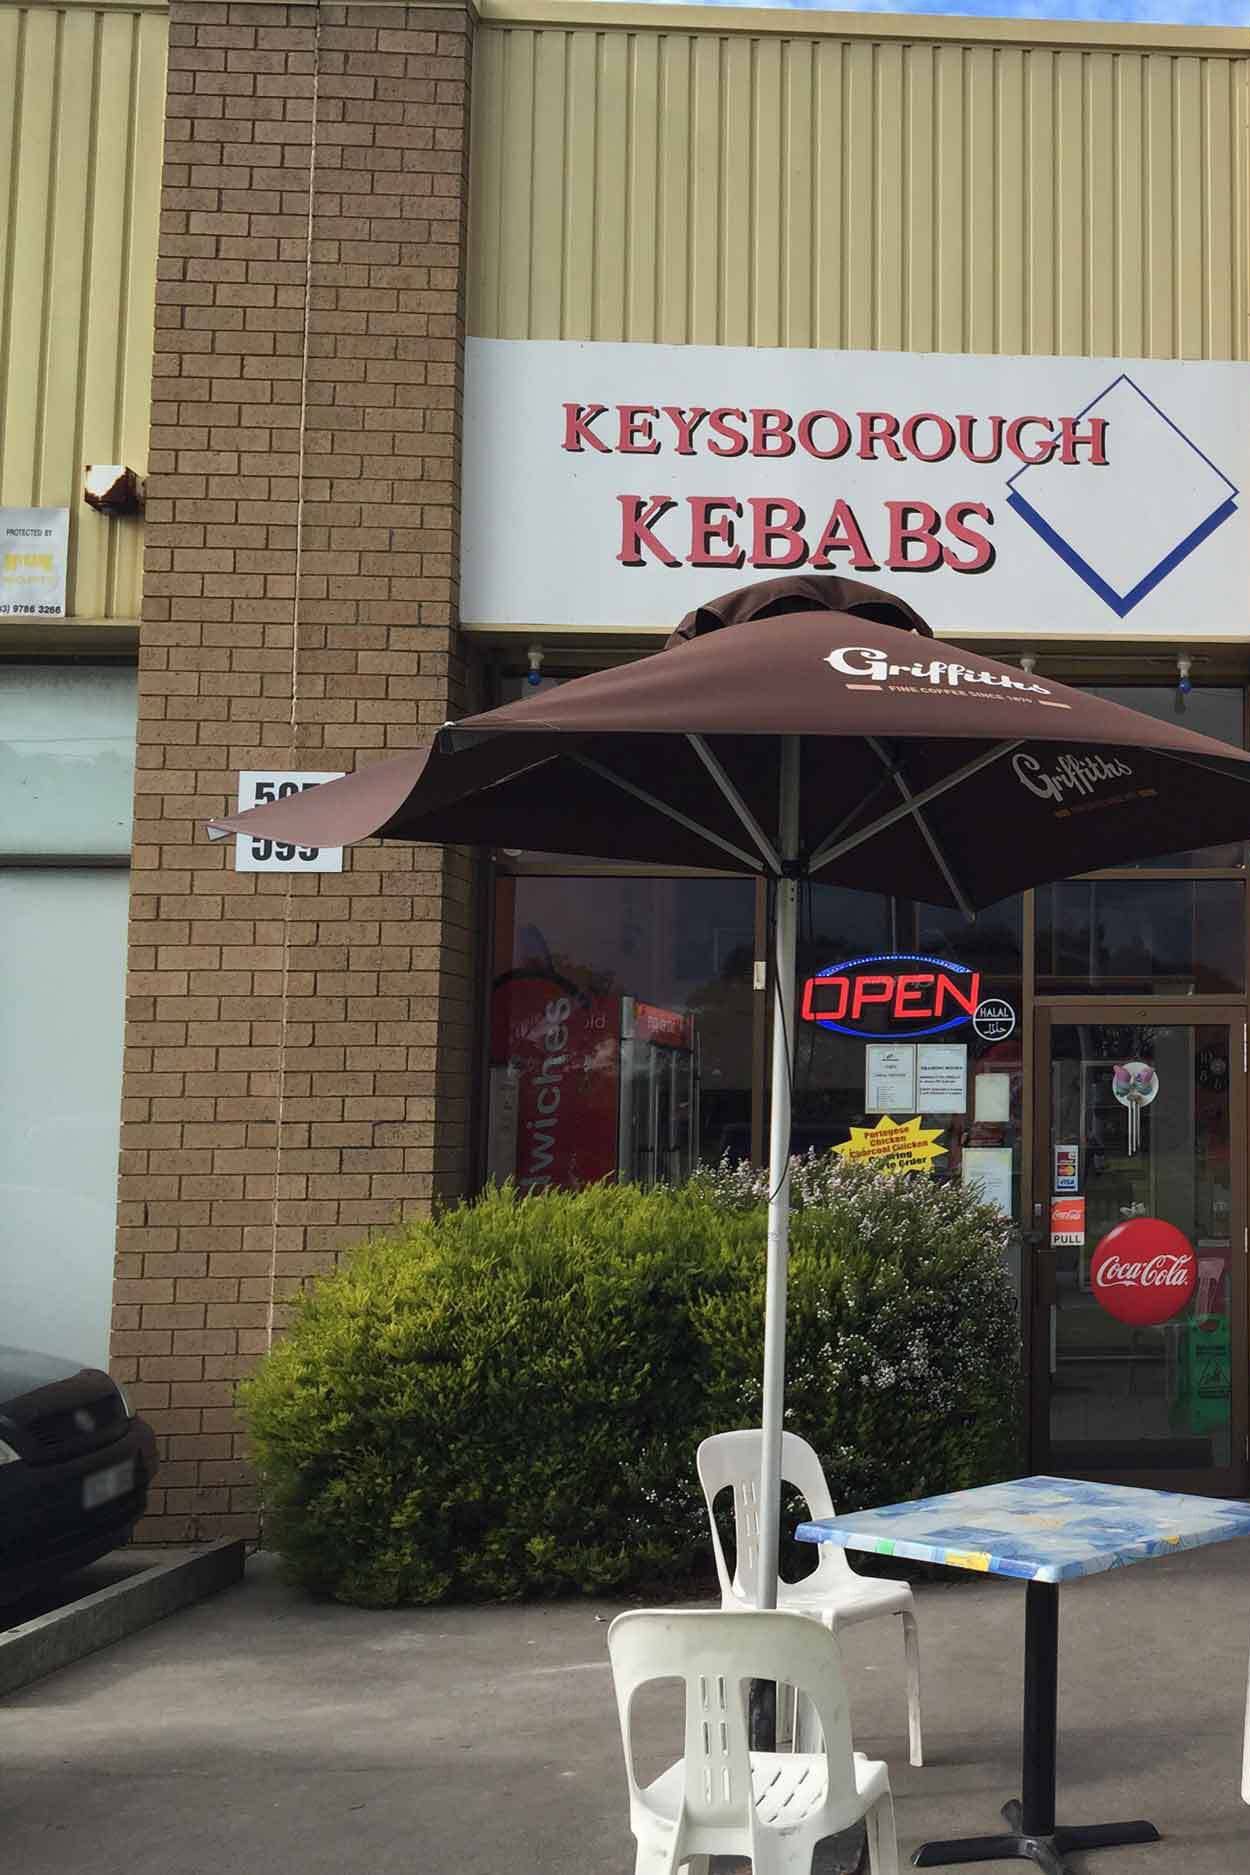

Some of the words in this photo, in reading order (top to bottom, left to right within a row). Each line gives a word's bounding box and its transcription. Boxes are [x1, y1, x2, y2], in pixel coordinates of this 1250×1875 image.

[560, 402, 1110, 466] KEYSBOROUGH
[6, 528, 42, 537] PROTECTED
[615, 494, 997, 573] KEBABS
[824, 647, 1052, 695] Griffiths
[1011, 752, 1133, 803] Griffiths
[802, 971, 980, 1021] OPEN
[979, 1007, 1009, 1018] HALAL
[520, 995, 572, 1186] wiches
[1054, 1234, 1082, 1244] PULL
[1096, 1254, 1193, 1287] Coca-Cola
